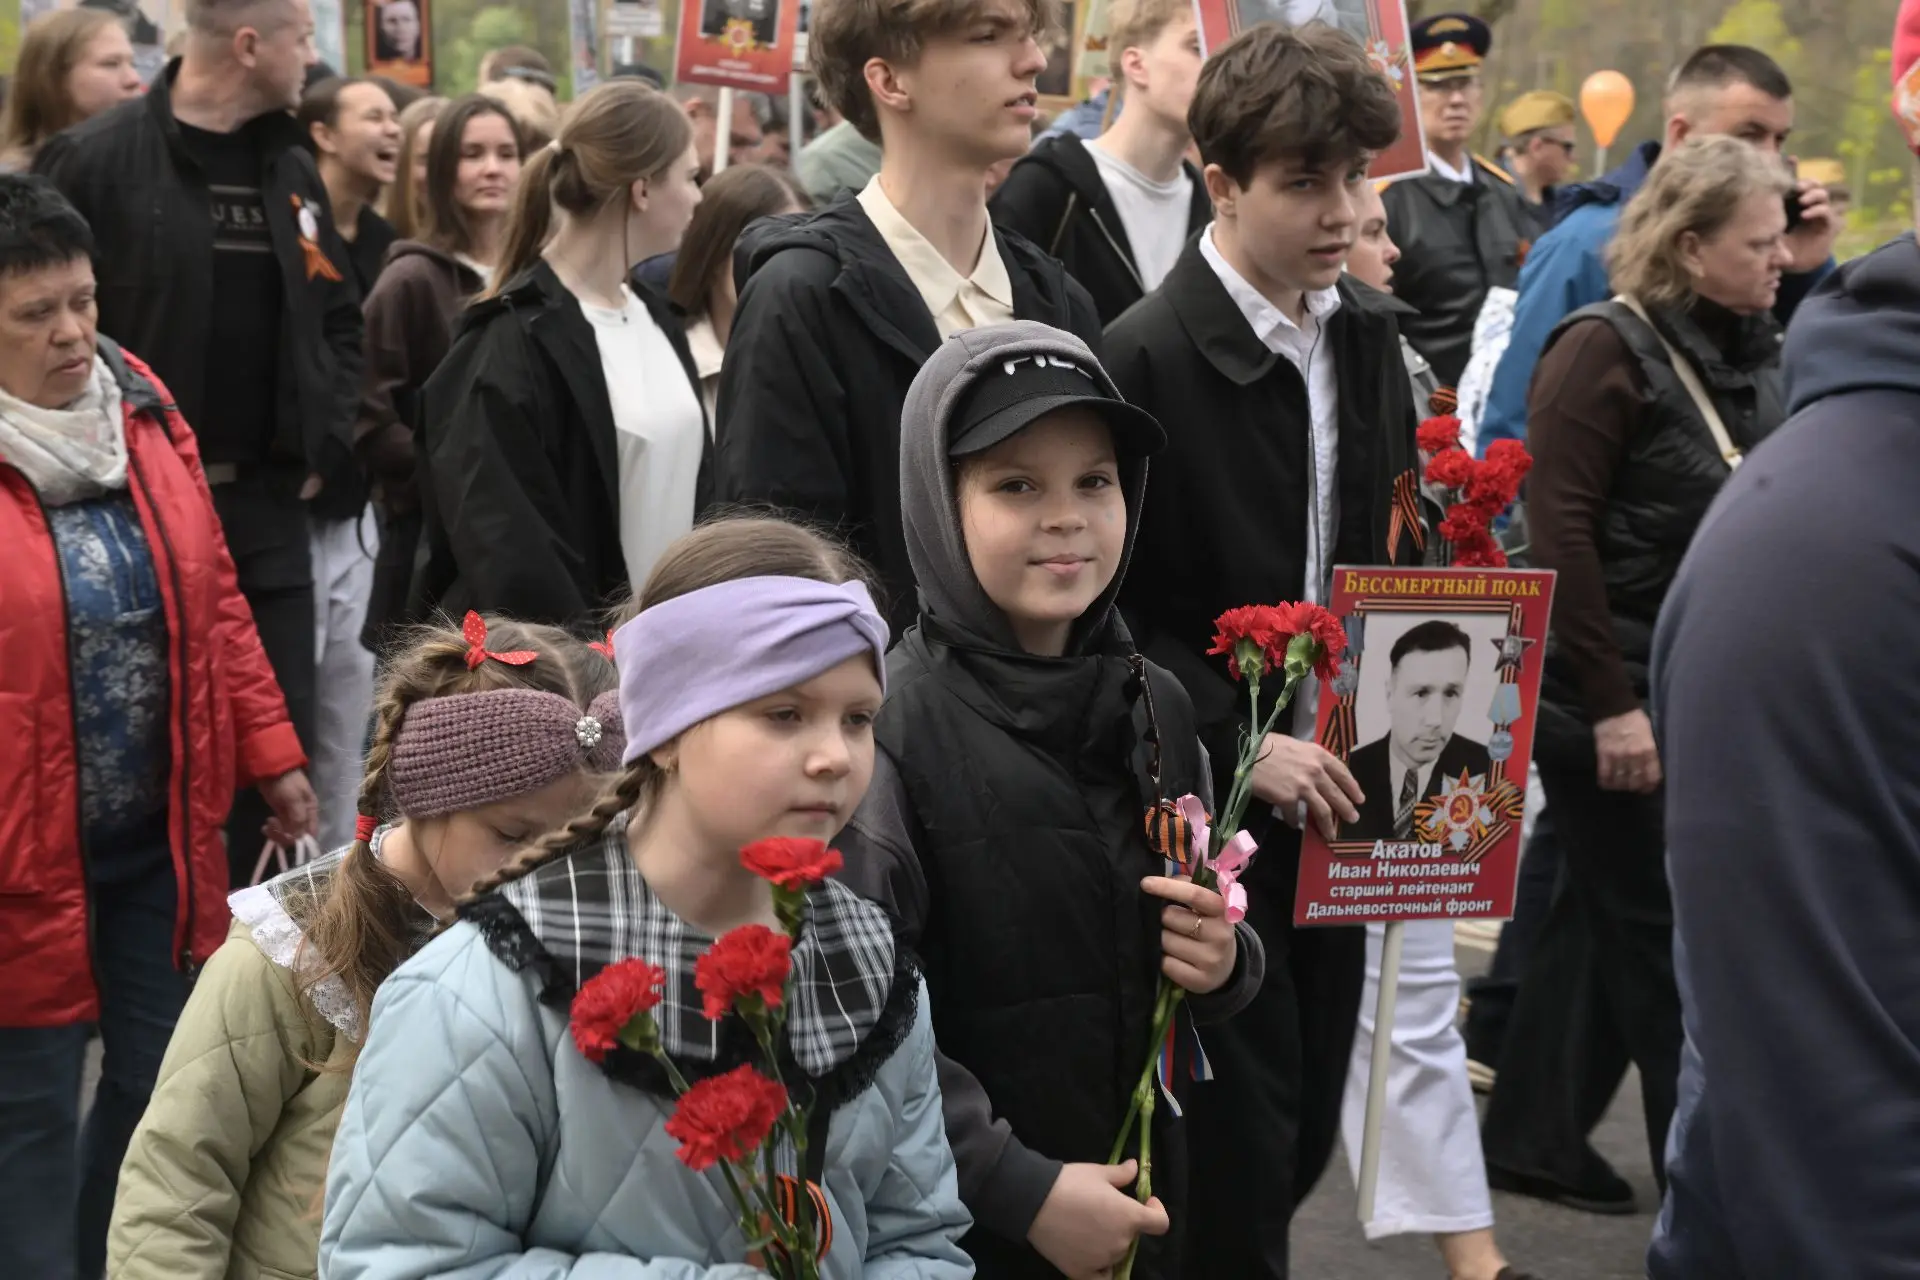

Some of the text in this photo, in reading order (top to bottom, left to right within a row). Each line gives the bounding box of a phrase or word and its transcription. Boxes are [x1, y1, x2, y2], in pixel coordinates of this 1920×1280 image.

[1370, 839, 1443, 859] Акатов
[1328, 861, 1480, 879] Иван Николаевич
[1329, 881, 1475, 900] старший лейтенант
[1306, 898, 1493, 920] Дальневосточный фронт
